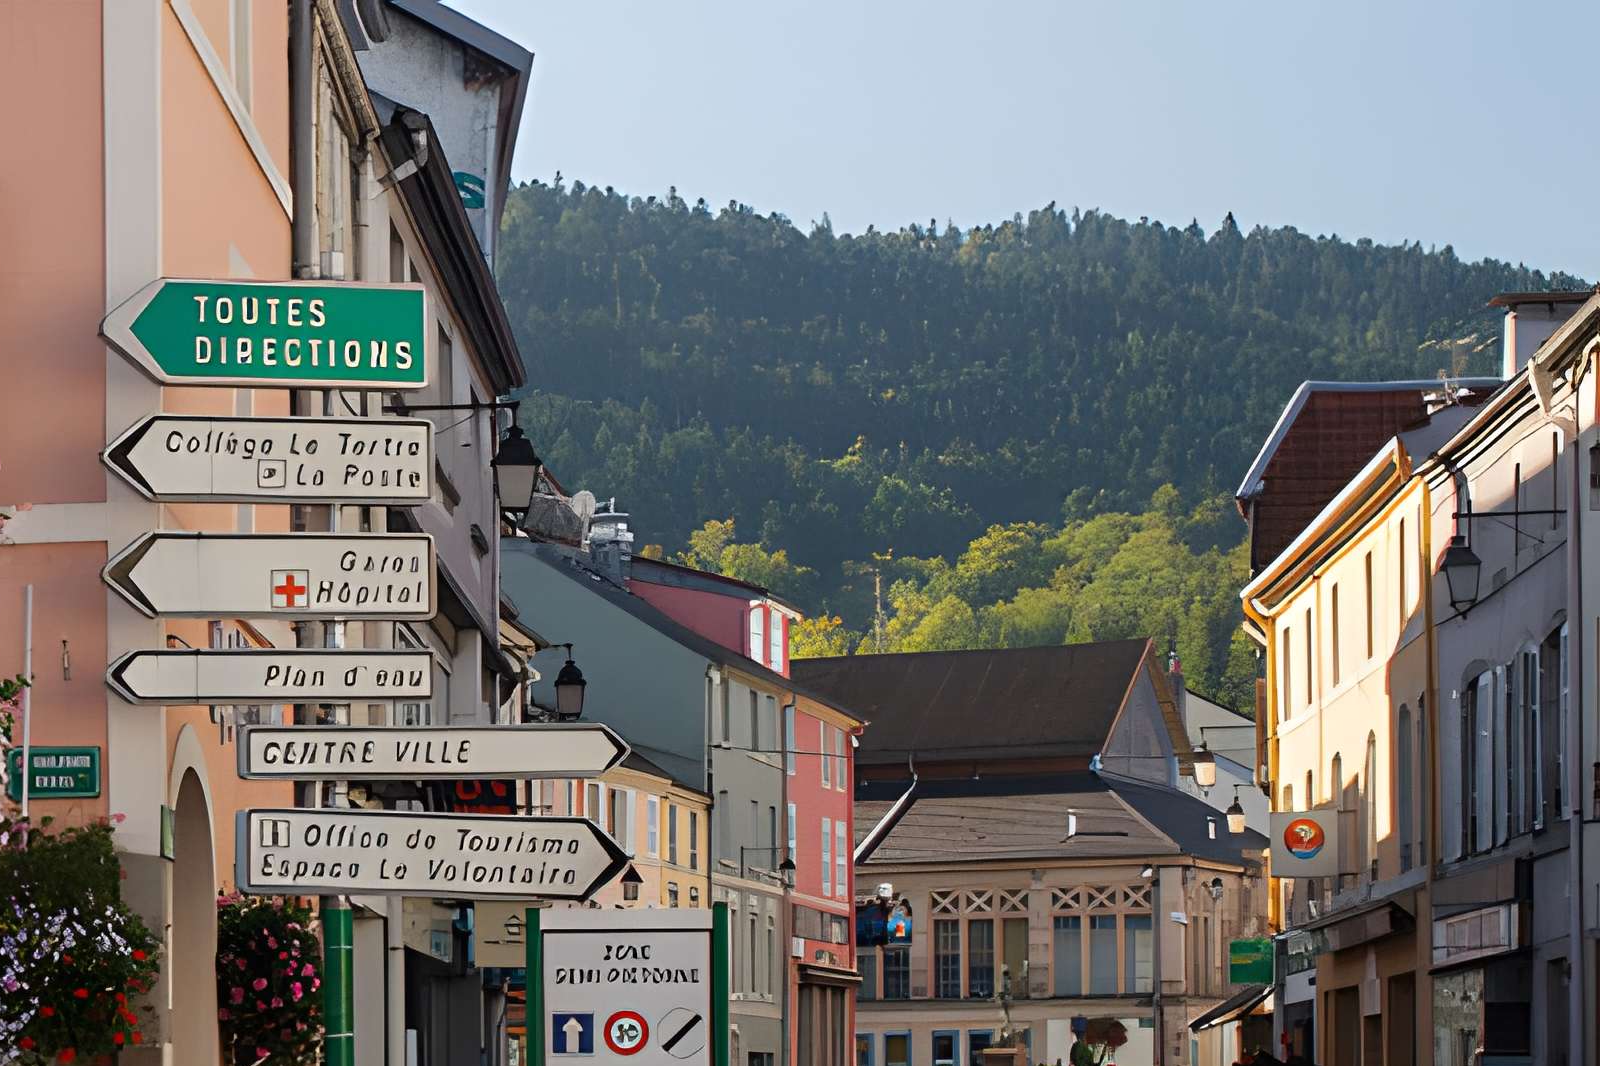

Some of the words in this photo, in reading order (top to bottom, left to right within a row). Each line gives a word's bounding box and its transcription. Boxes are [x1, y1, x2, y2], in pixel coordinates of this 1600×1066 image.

[193, 295, 326, 327] TOUTES
[195, 336, 413, 370] DIRECTIONS
[316, 580, 422, 606] Hôpital
[264, 664, 325, 687] Plan
[263, 740, 375, 765] CENTRE
[396, 739, 471, 764] VILLE
